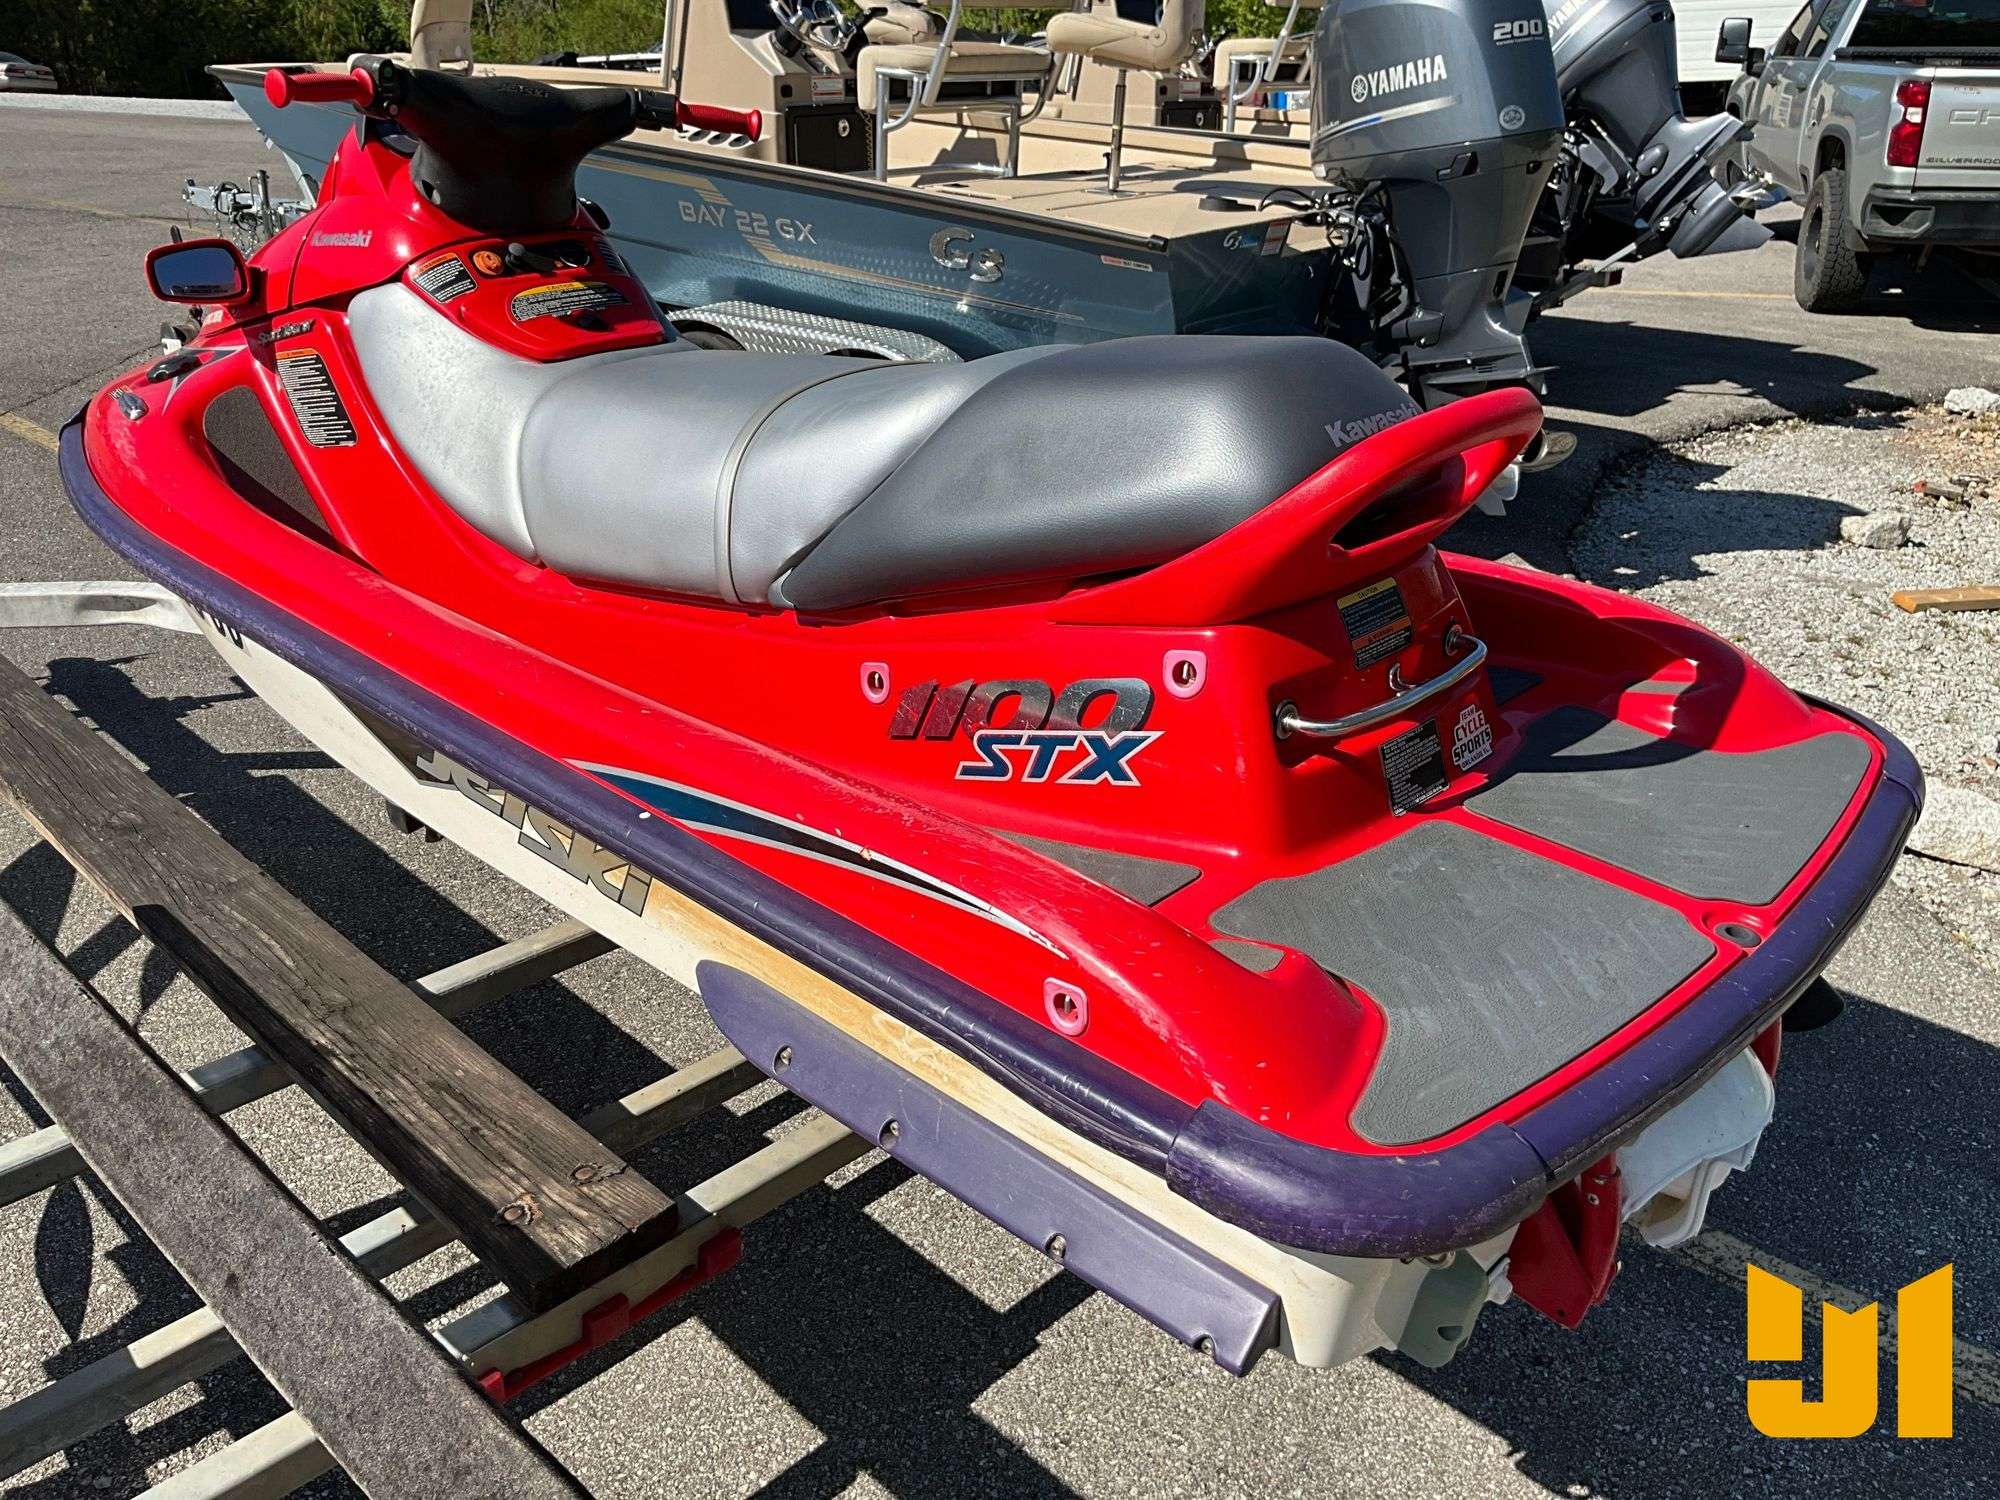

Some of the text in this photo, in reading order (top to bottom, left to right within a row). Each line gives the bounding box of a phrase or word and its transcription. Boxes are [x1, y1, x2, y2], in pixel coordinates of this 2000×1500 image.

[1493, 19, 1543, 41] 200
[1367, 54, 1447, 97] YAMAHA
[312, 229, 374, 248] Kawasaki
[678, 200, 817, 245] BAY 22 GX
[928, 227, 1004, 283] G3
[889, 677, 1156, 740] 1100
[1455, 712, 1484, 742] CYCLE
[955, 729, 1167, 786] STX
[1453, 727, 1491, 762] SPORTS
